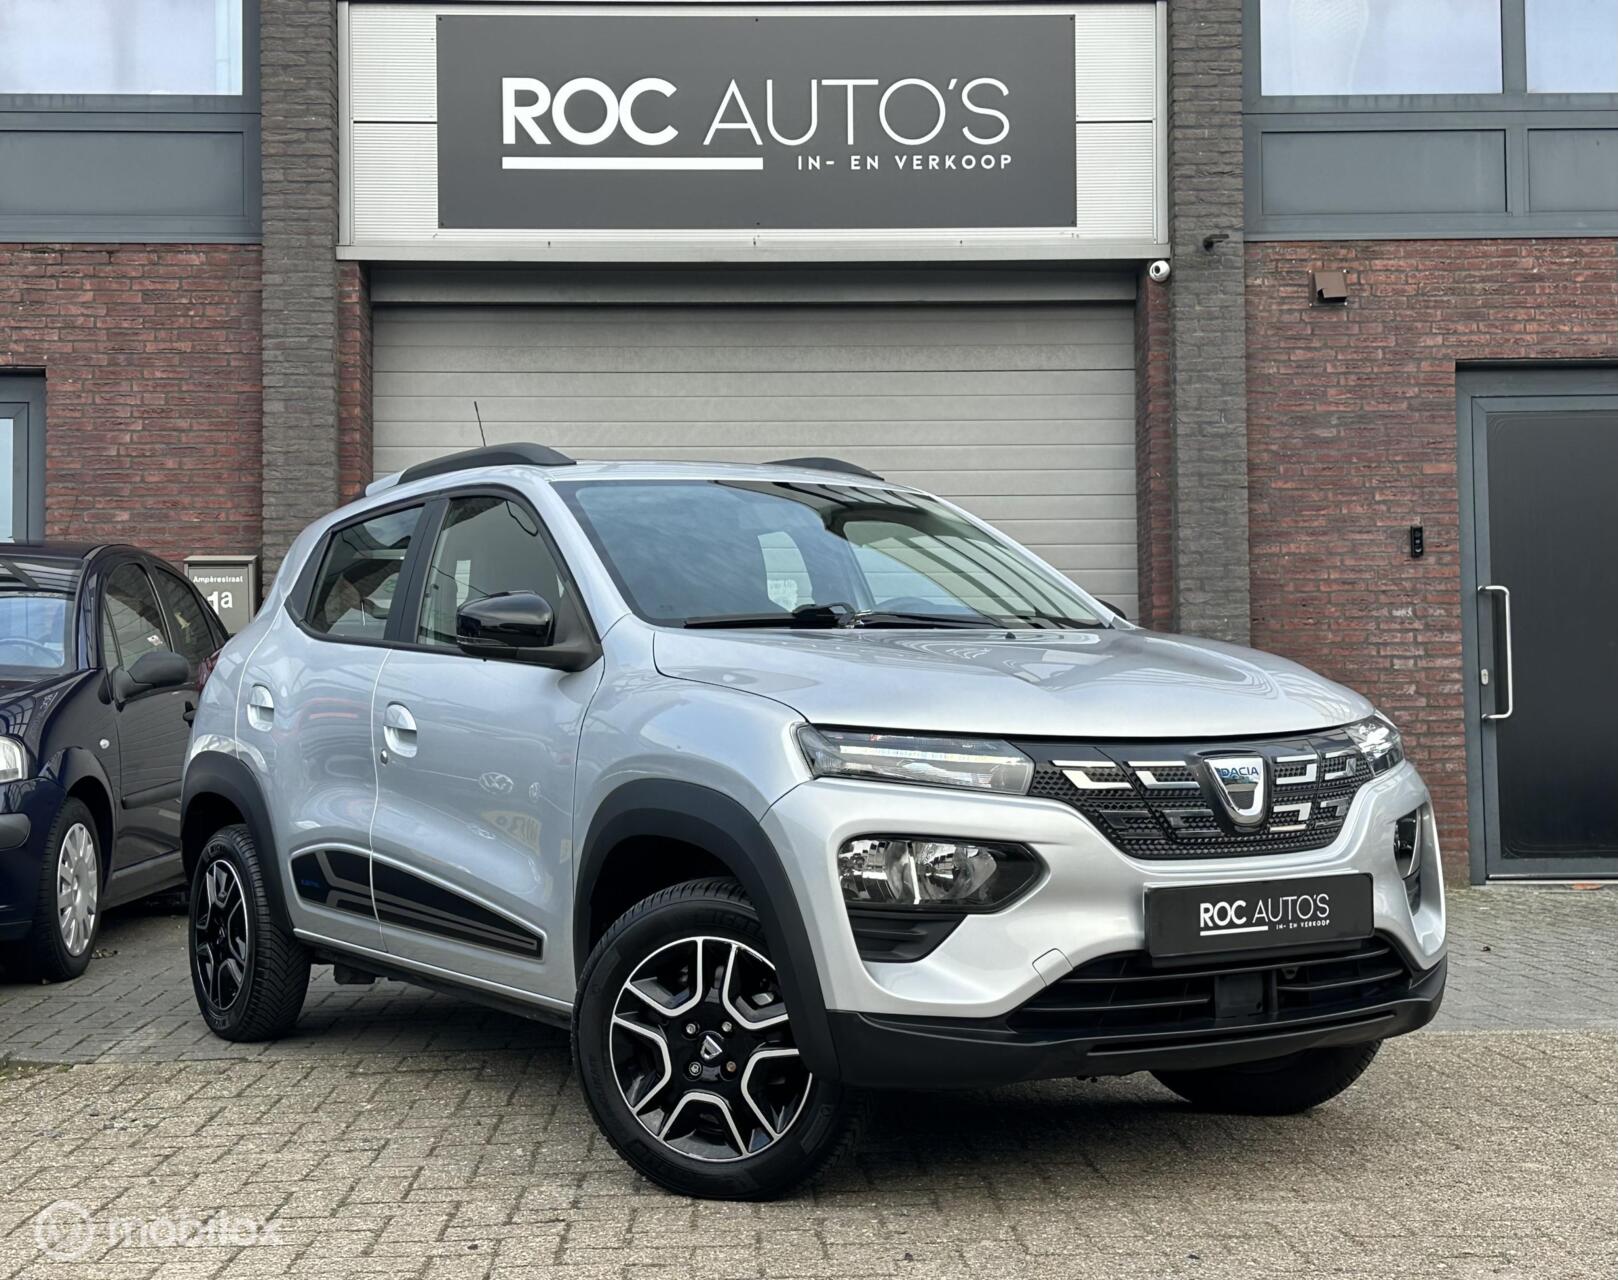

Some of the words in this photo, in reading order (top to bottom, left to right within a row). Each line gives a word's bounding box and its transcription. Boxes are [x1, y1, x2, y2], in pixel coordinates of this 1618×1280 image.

[502, 77, 679, 145] ROC
[703, 77, 1010, 146] AUTO'S
[798, 155, 835, 170] IN-
[851, 155, 879, 169] EN
[895, 154, 1013, 170] VERKOOP
[207, 591, 232, 615] 1a
[1220, 766, 1259, 777] DACIA
[1200, 900, 1247, 928] ROC
[1252, 893, 1330, 923] AUTO'S
[1300, 919, 1330, 928] VERKOOP
